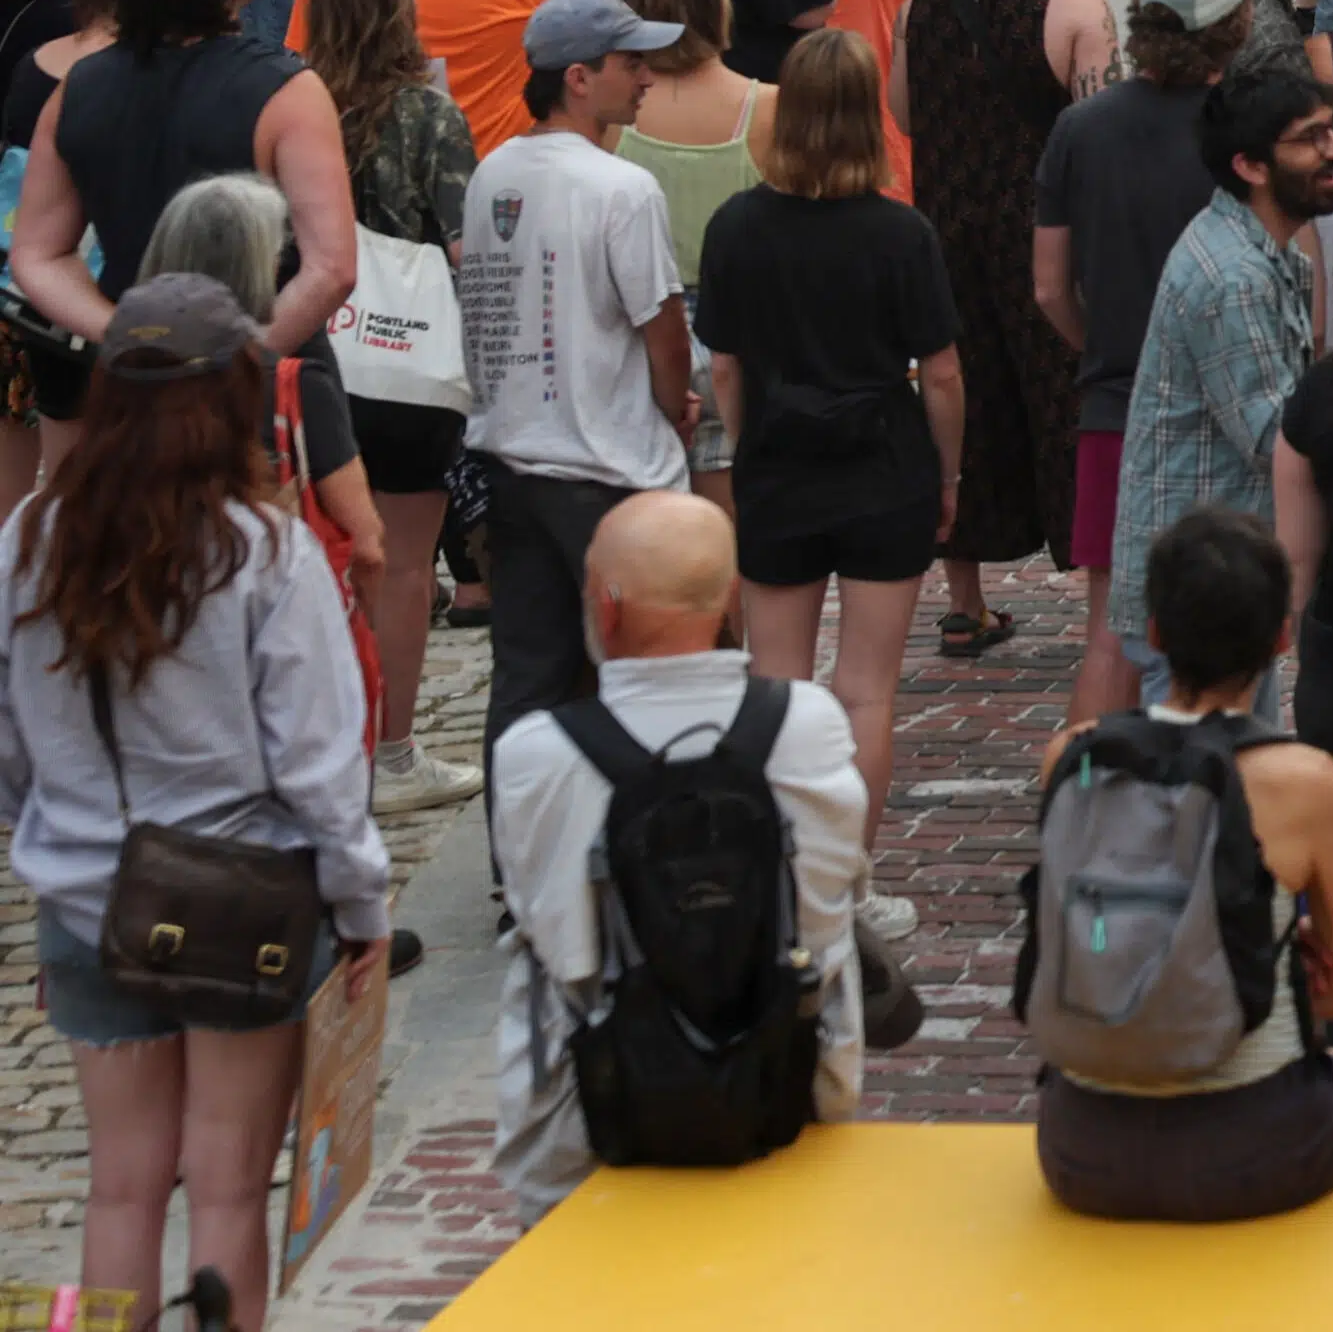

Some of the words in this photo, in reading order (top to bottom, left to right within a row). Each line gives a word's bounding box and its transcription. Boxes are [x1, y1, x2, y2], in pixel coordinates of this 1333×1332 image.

[368, 312, 429, 331] PORTLAND
[365, 326, 406, 340] PUBLIC
[363, 335, 413, 352] LIBRARY
